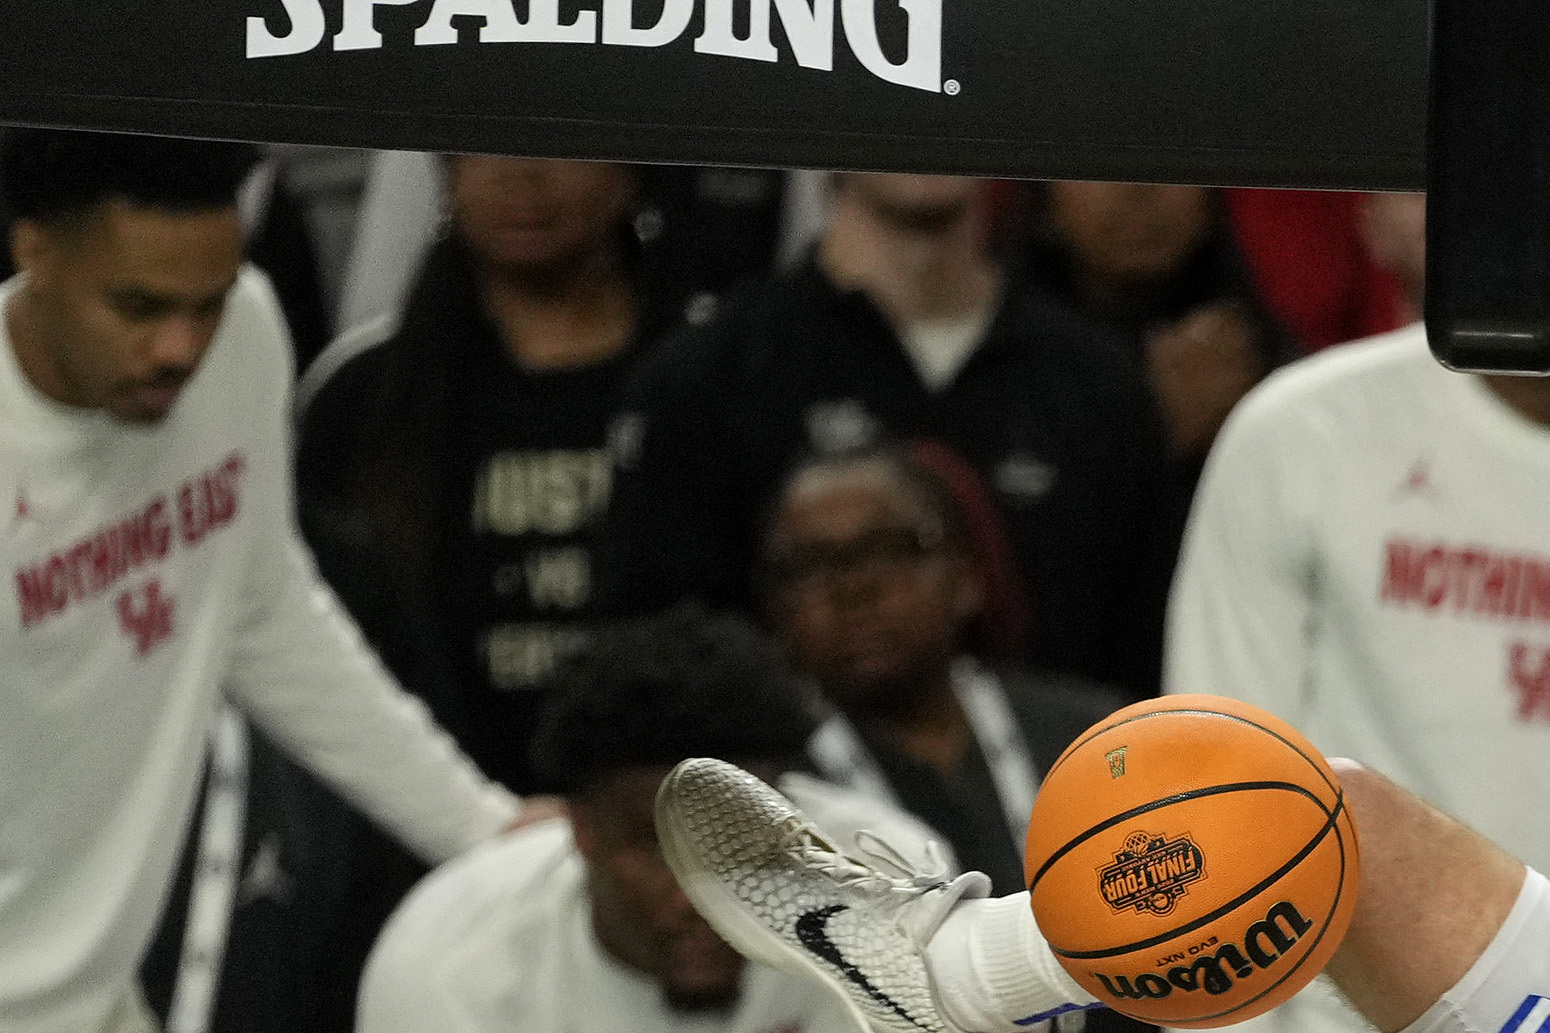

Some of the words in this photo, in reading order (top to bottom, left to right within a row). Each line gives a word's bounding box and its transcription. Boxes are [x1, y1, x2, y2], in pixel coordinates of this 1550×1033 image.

[15, 497, 172, 626] NOTHING
[177, 454, 245, 546] EAS
[1147, 848, 1196, 884] FINAL
[1104, 868, 1148, 901] FOUR
[1094, 901, 1314, 999] Wilson
[1156, 952, 1185, 968] NXT
[1188, 936, 1220, 956] EVO
